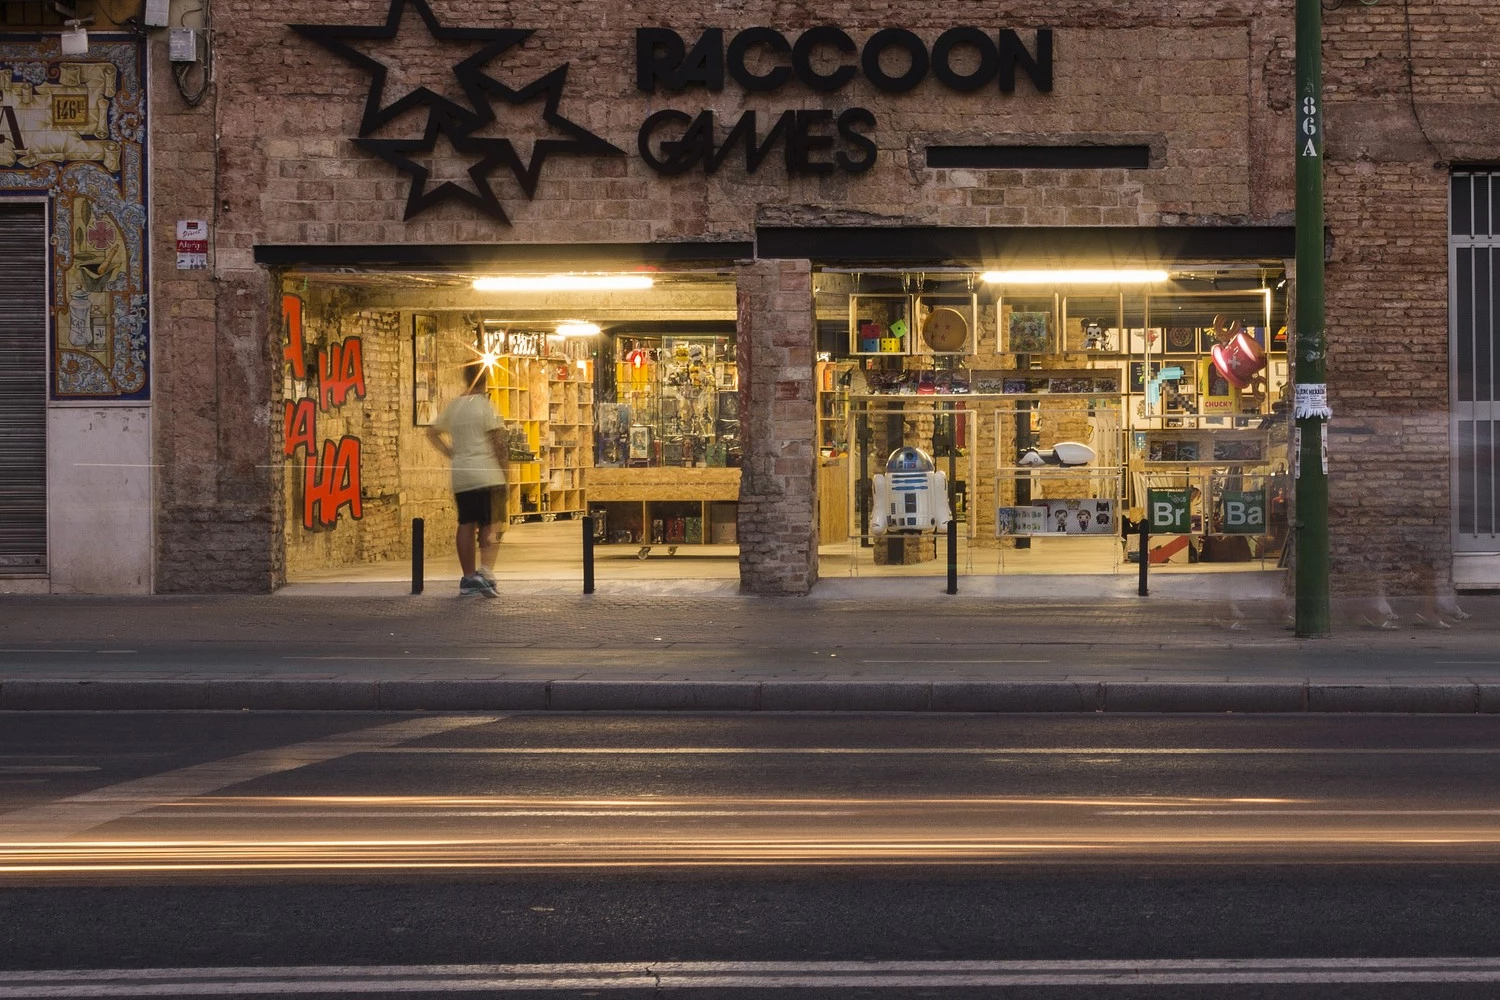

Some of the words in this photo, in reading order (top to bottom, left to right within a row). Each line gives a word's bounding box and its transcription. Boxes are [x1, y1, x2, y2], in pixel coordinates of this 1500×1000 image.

[636, 26, 1053, 92] RACCOON
[637, 107, 878, 175] GAMES
[318, 336, 366, 413] HA
[303, 435, 363, 532] HA
[1153, 501, 1186, 527] Br
[1227, 501, 1264, 526] Ba
